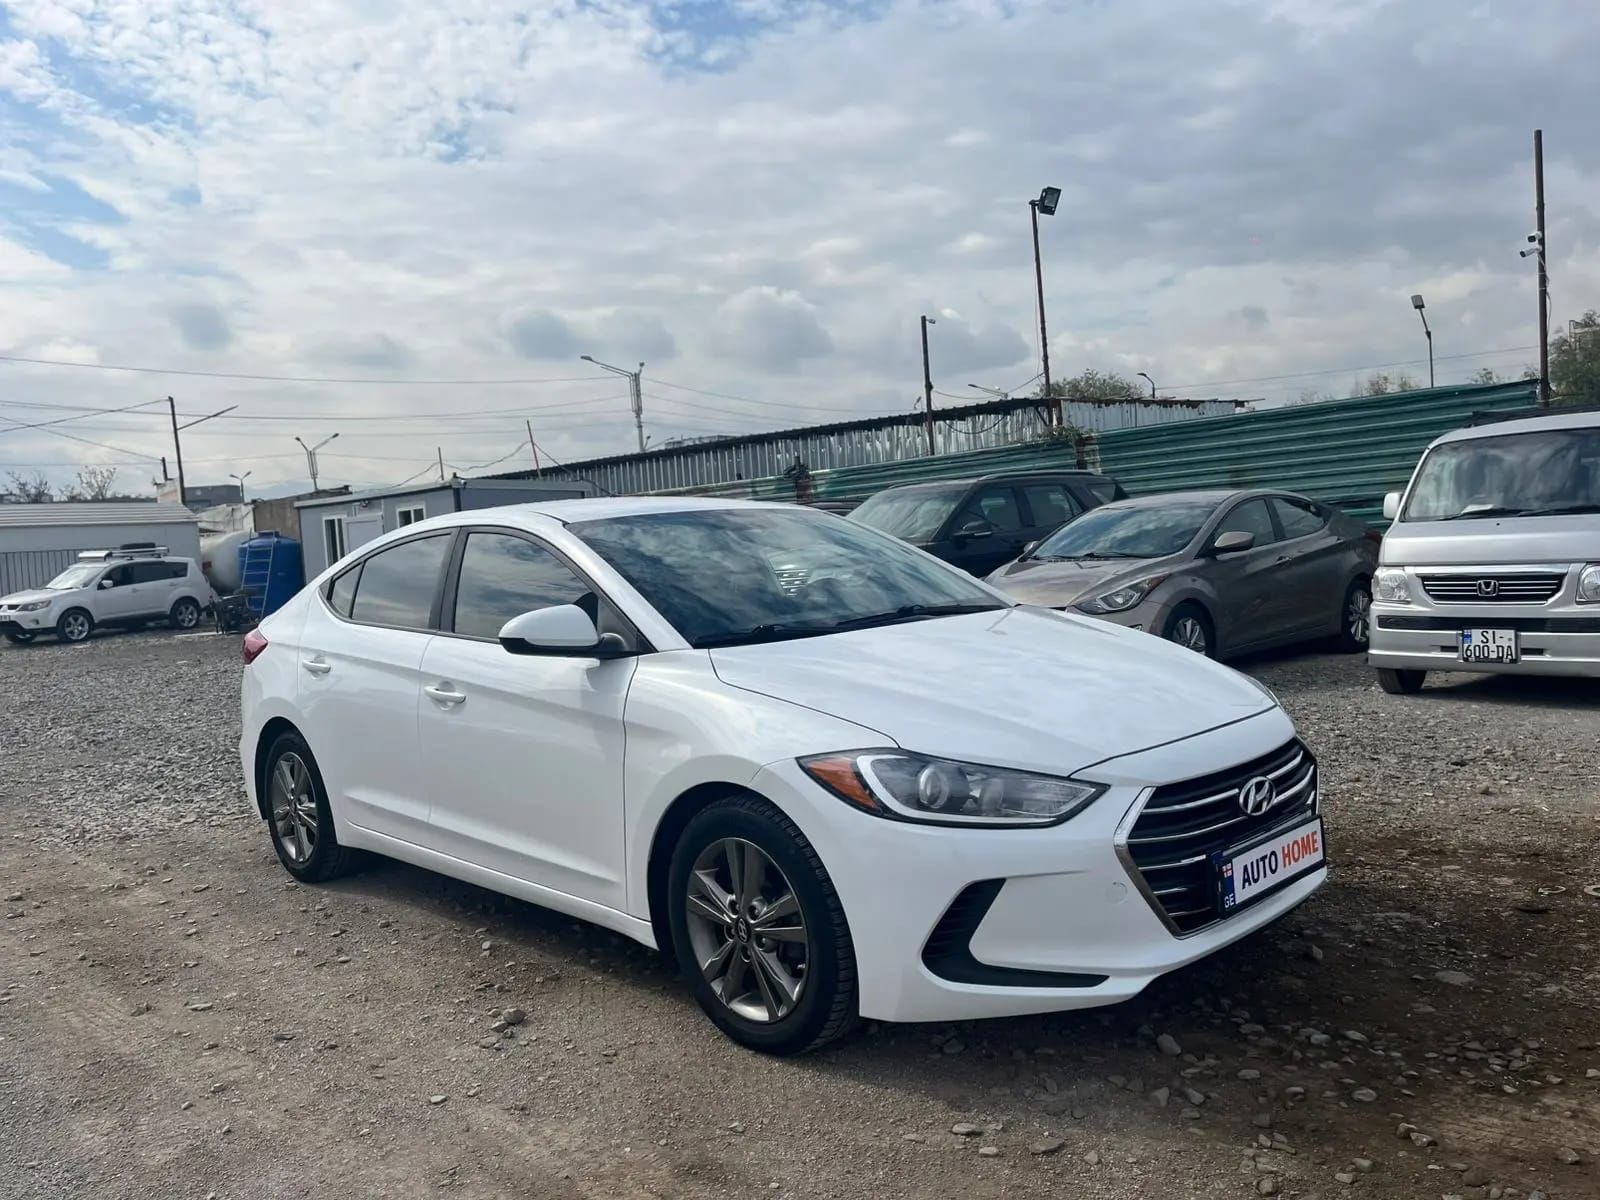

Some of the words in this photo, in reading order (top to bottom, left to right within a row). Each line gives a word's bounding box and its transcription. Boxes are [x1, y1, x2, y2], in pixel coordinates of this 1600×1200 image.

[1464, 645, 1514, 659] 600-DA
[1241, 850, 1279, 889] AUTO
[1281, 831, 1319, 868] HOME
[1223, 894, 1235, 908] GE
